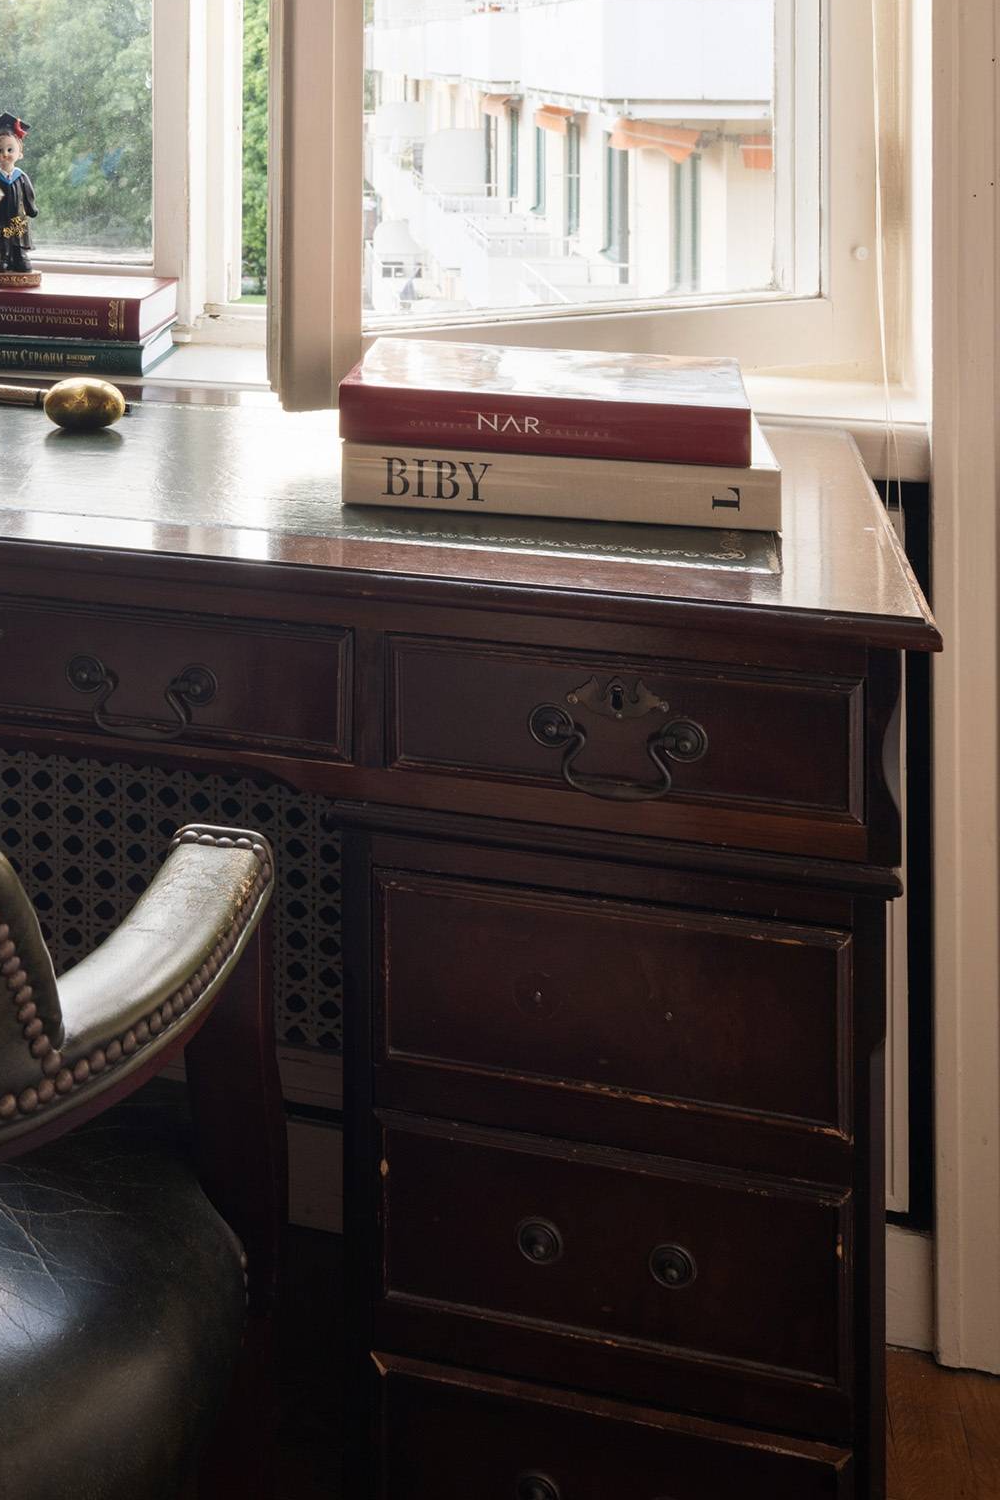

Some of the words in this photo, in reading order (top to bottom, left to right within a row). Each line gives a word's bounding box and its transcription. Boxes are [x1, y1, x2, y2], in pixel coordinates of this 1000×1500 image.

[84, 317, 99, 326] ПО
[477, 412, 541, 435] NAR
[381, 456, 493, 503] BIBY
[711, 486, 741, 512] L
